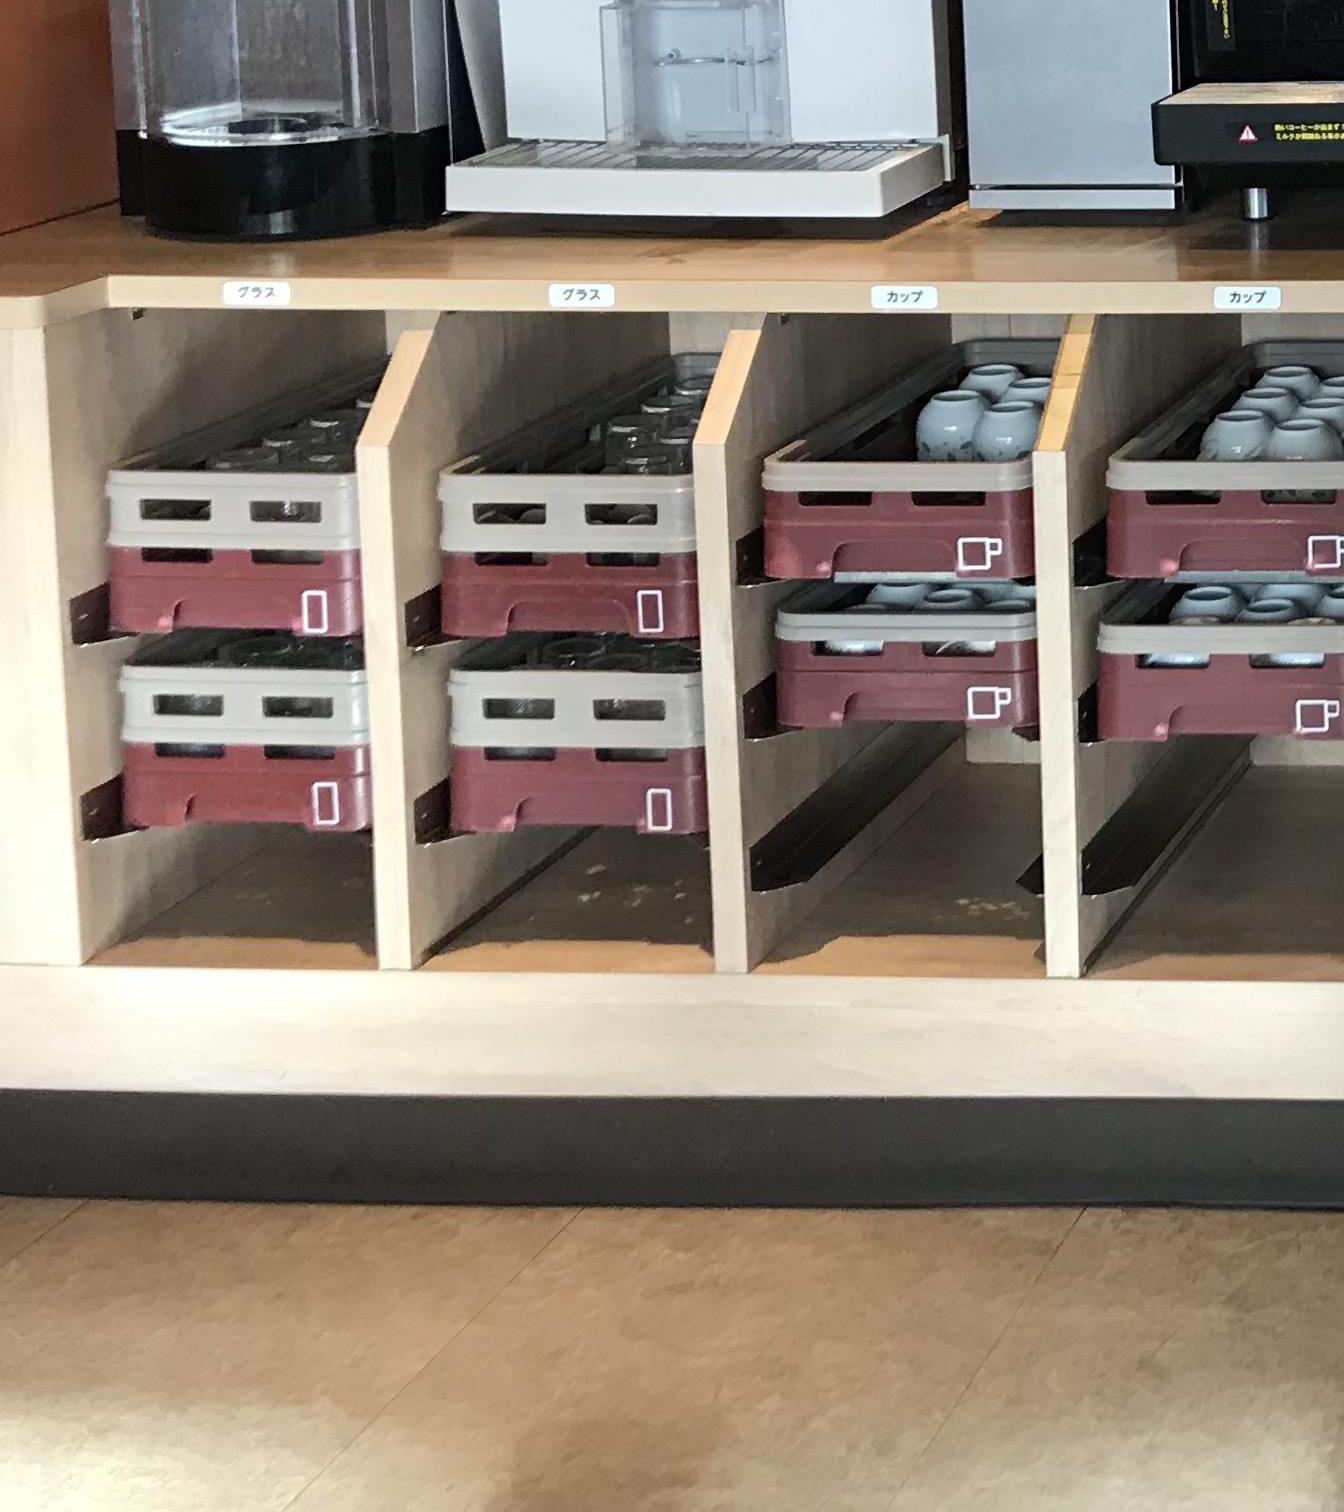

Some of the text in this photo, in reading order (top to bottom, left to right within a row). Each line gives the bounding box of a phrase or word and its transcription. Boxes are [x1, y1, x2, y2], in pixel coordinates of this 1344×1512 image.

[237, 286, 277, 299] グラス
[562, 287, 601, 301] グラス
[887, 290, 924, 303] カップ
[1229, 291, 1267, 304] カップ
